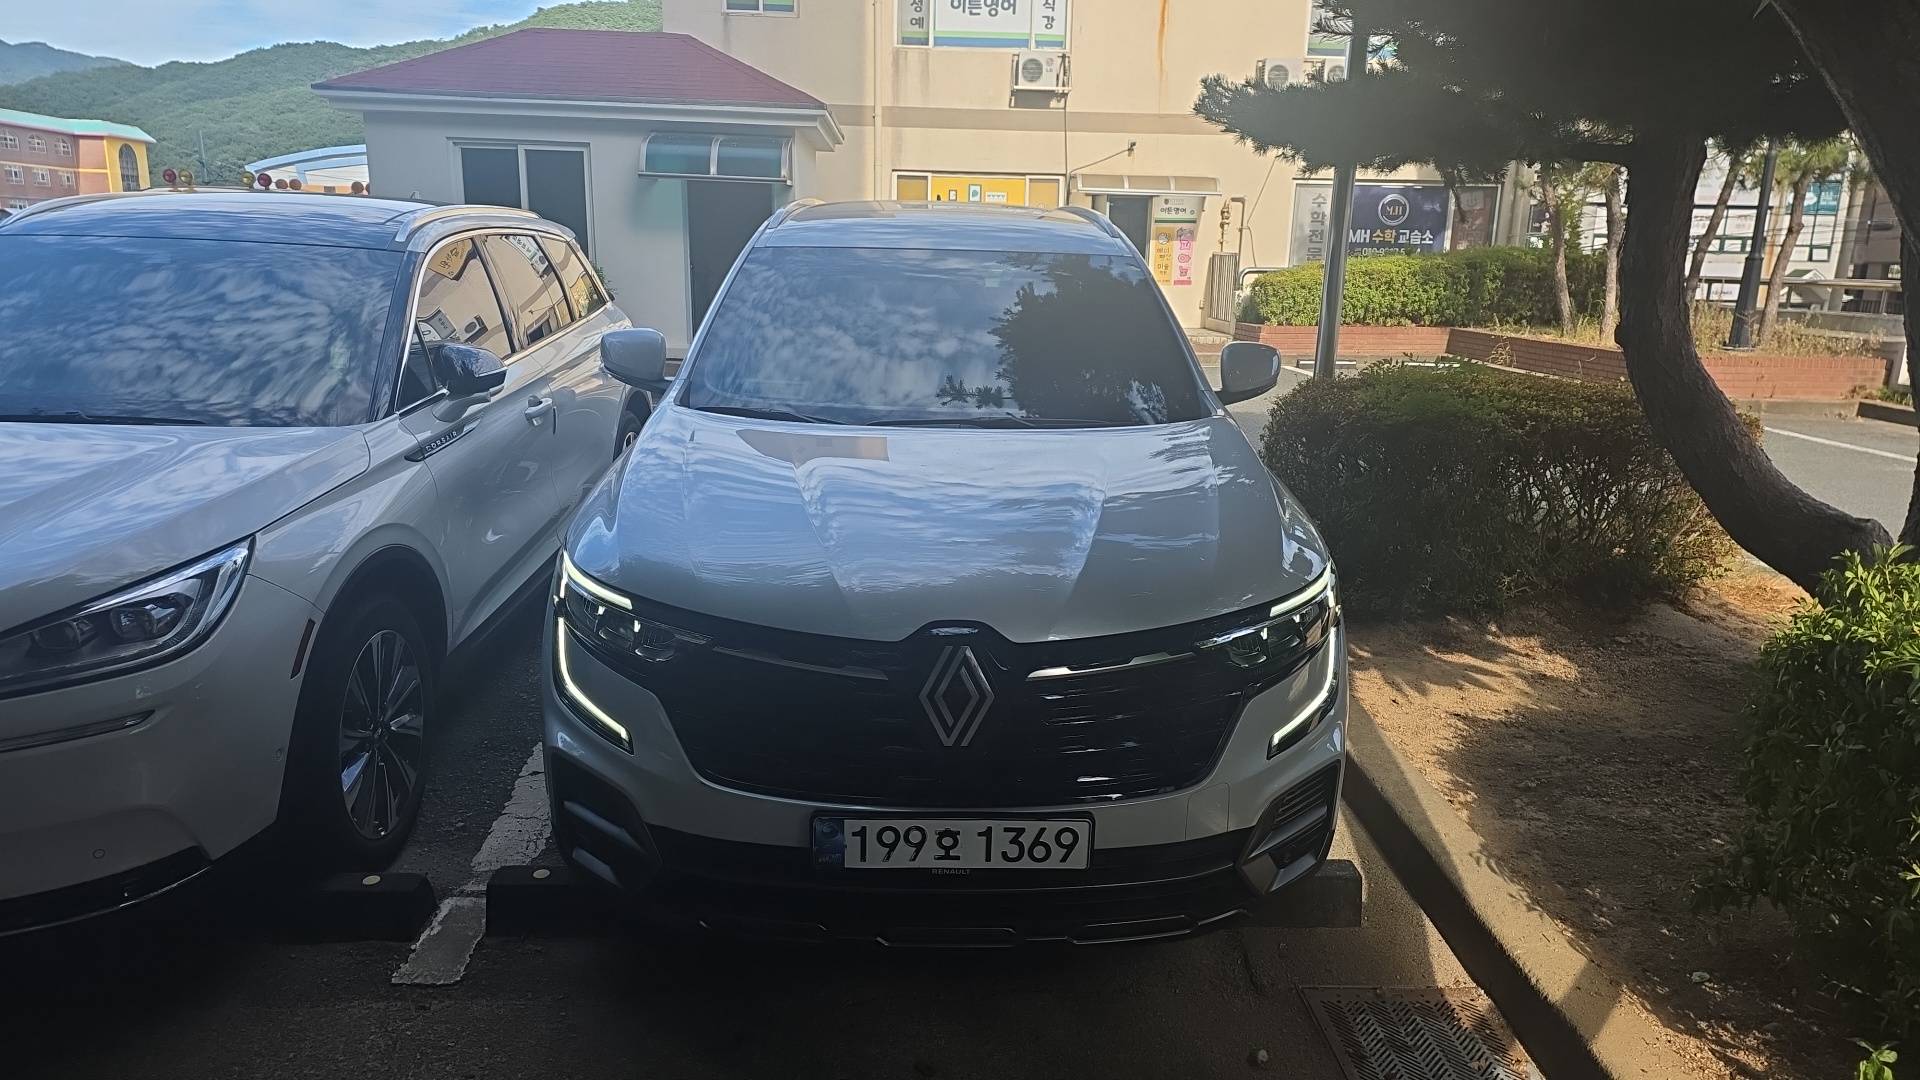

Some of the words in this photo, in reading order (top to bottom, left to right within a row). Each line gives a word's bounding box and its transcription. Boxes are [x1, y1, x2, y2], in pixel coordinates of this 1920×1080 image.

[1160, 206, 1187, 215] 이튼영어
[1349, 229, 1371, 243] MH
[1372, 228, 1397, 244] 수학
[1398, 229, 1434, 245] 교습소
[425, 431, 457, 451] CORSAIR
[850, 825, 962, 863] 199호
[976, 825, 1081, 863] 1369
